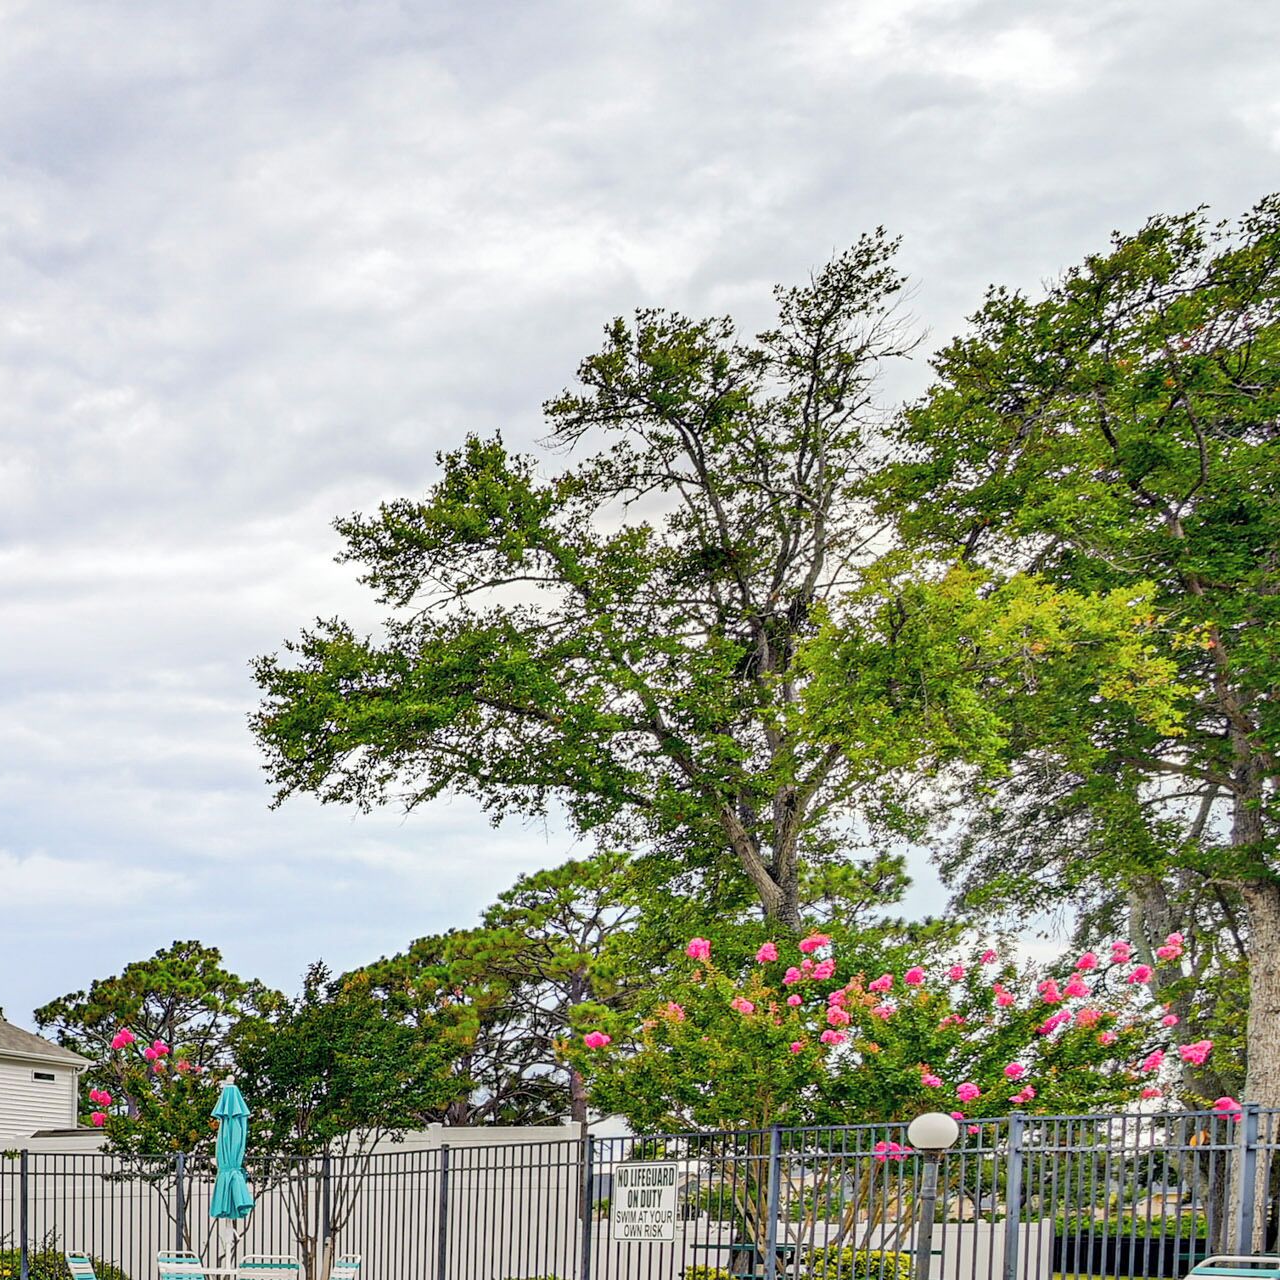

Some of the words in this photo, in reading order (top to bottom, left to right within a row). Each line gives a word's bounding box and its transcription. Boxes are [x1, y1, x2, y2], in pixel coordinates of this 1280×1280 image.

[617, 1169, 629, 1188] NO
[630, 1167, 674, 1187] LIFEGUARD
[627, 1189, 639, 1208] ON
[640, 1189, 663, 1208] DUTY
[616, 1210, 637, 1224] SWIM
[639, 1210, 648, 1223] AT
[650, 1210, 673, 1224] YOUR
[623, 1224, 642, 1238] OWN
[645, 1224, 663, 1238] RISK
